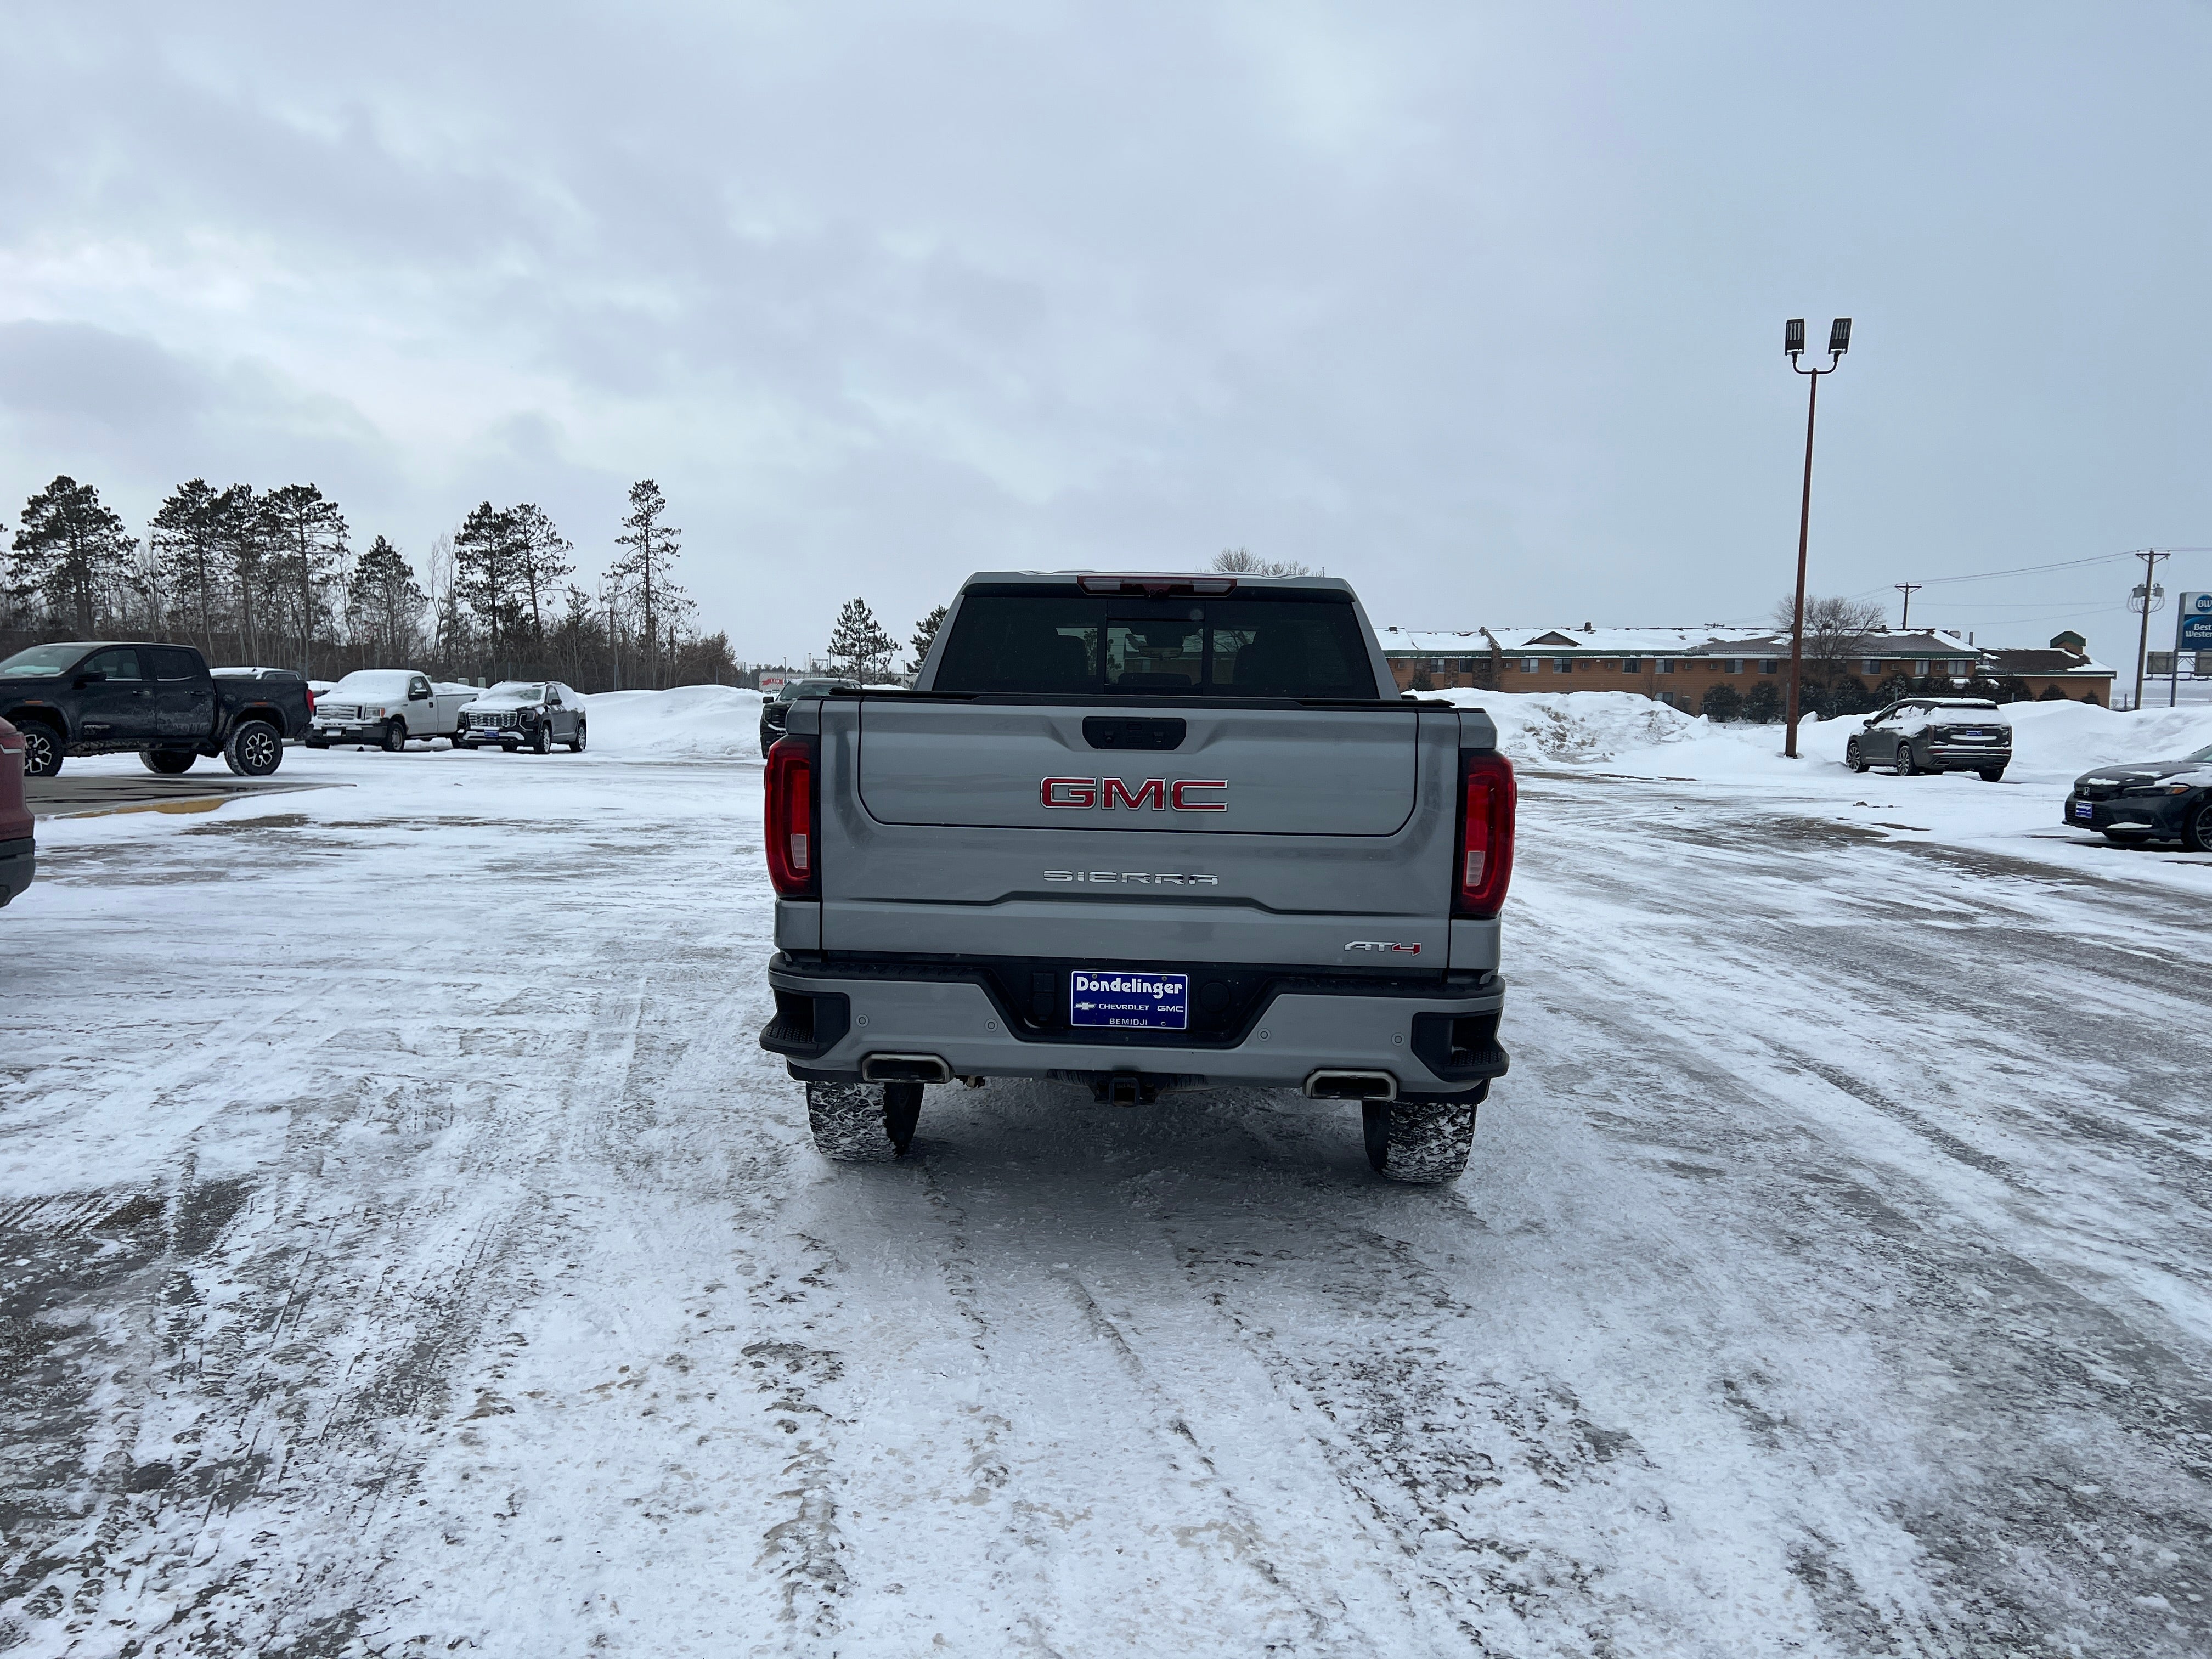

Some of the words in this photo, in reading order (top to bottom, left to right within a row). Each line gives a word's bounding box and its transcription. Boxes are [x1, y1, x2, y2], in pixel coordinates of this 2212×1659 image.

[1040, 776, 1228, 812] GMC
[1043, 870, 1219, 885] SIERRA
[1344, 941, 1422, 956] AT4
[1076, 977, 1183, 999] Dondelinger
